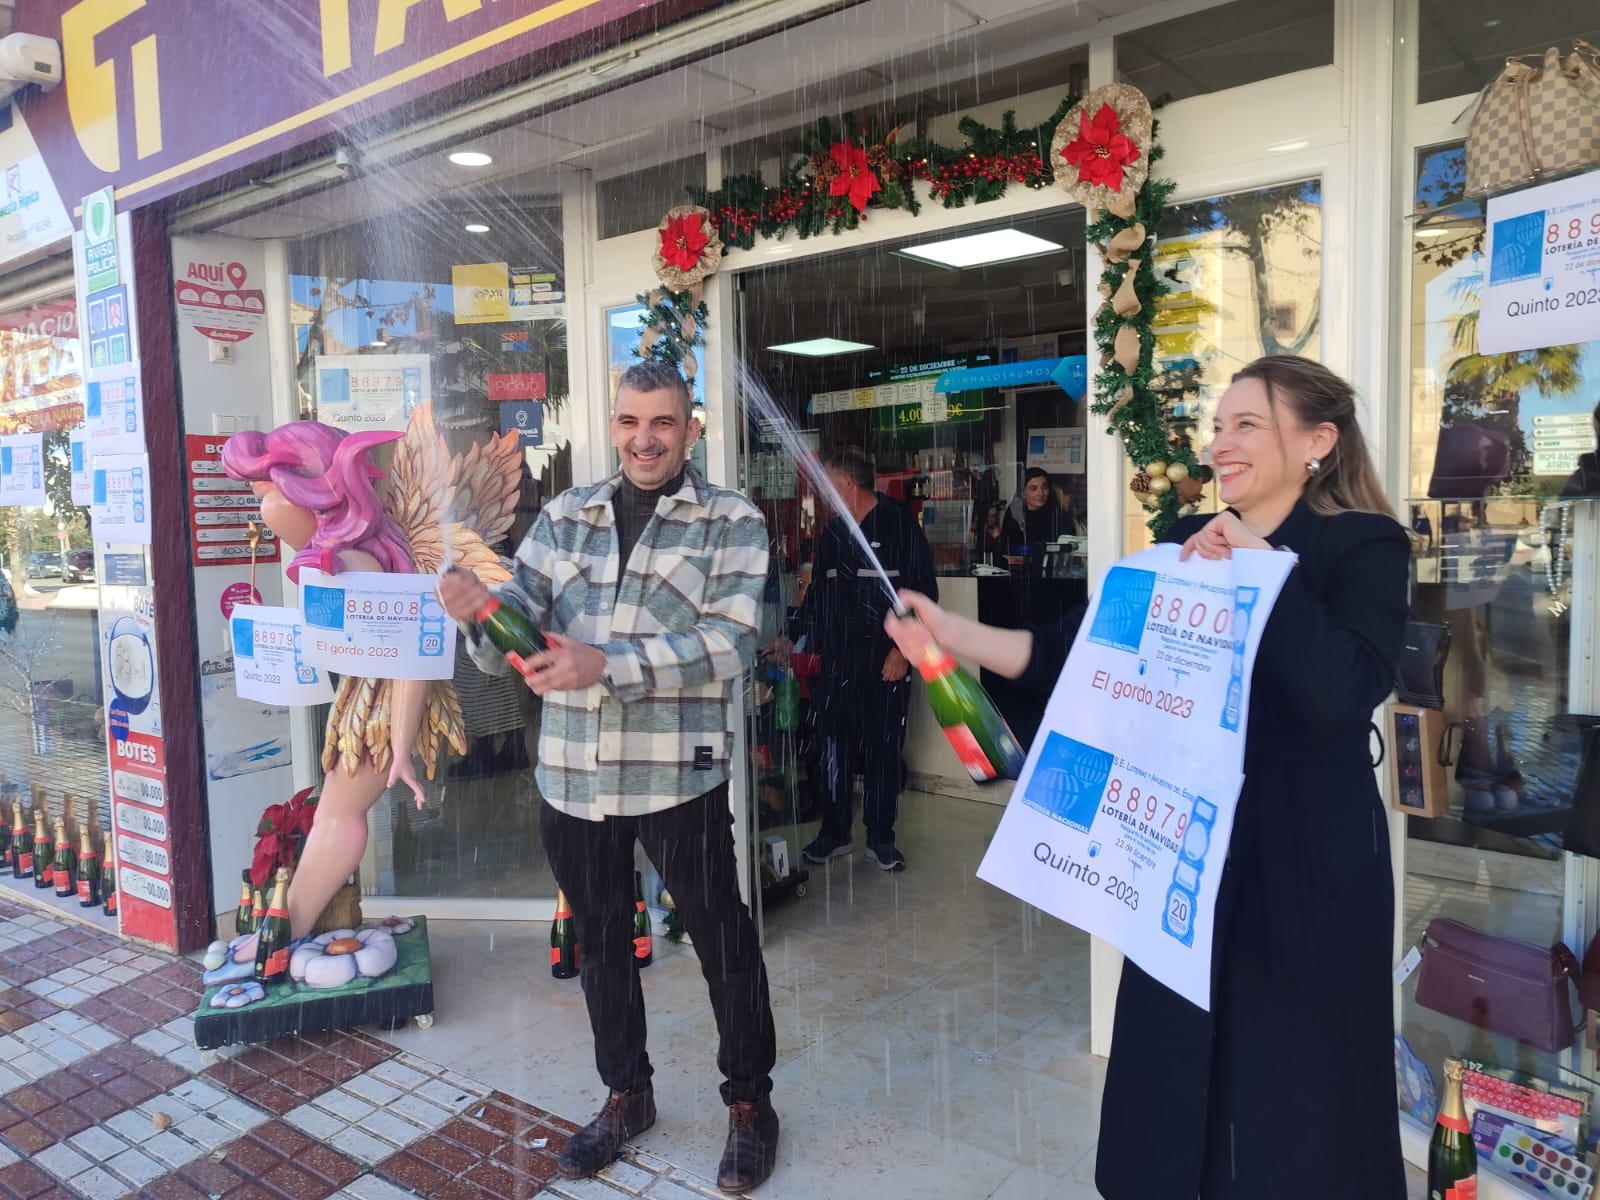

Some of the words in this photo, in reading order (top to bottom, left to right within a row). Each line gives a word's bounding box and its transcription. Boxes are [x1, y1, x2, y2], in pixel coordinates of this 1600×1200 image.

[1545, 241, 1584, 256] LOTERÍA
[1586, 237, 1599, 246] DE
[187, 262, 225, 282] AQUÍ
[1507, 297, 1560, 317] Quinto
[900, 366, 908, 374] 22
[909, 364, 919, 372] DE
[920, 359, 956, 370] DICIEMBRE
[351, 376, 401, 388] 88979
[333, 413, 362, 422] Quinto
[364, 413, 386, 422] 2023
[347, 599, 419, 615] 88008
[1150, 593, 1235, 636] 8800
[254, 629, 293, 647] 88979
[1146, 621, 1177, 637] LOTERÍA
[1180, 629, 1195, 641] DE
[316, 640, 328, 651] El
[330, 644, 365, 657] gordo
[367, 646, 399, 658] 2023
[425, 638, 438, 648] 20
[263, 673, 280, 685] 2023
[301, 668, 311, 677] 20
[1091, 669, 1111, 690] El
[1112, 680, 1153, 706] gordo
[1155, 690, 1195, 719] 2023
[116, 739, 157, 765] BOTES
[1106, 778, 1188, 840] 88979
[1101, 803, 1137, 828] LOTERÍA
[1138, 821, 1149, 835] DE
[1149, 828, 1180, 854] NAVIDAD
[1114, 837, 1125, 849] 22
[1033, 841, 1101, 887] Quinto
[1103, 876, 1140, 912] 2023
[1171, 898, 1188, 922] 20
